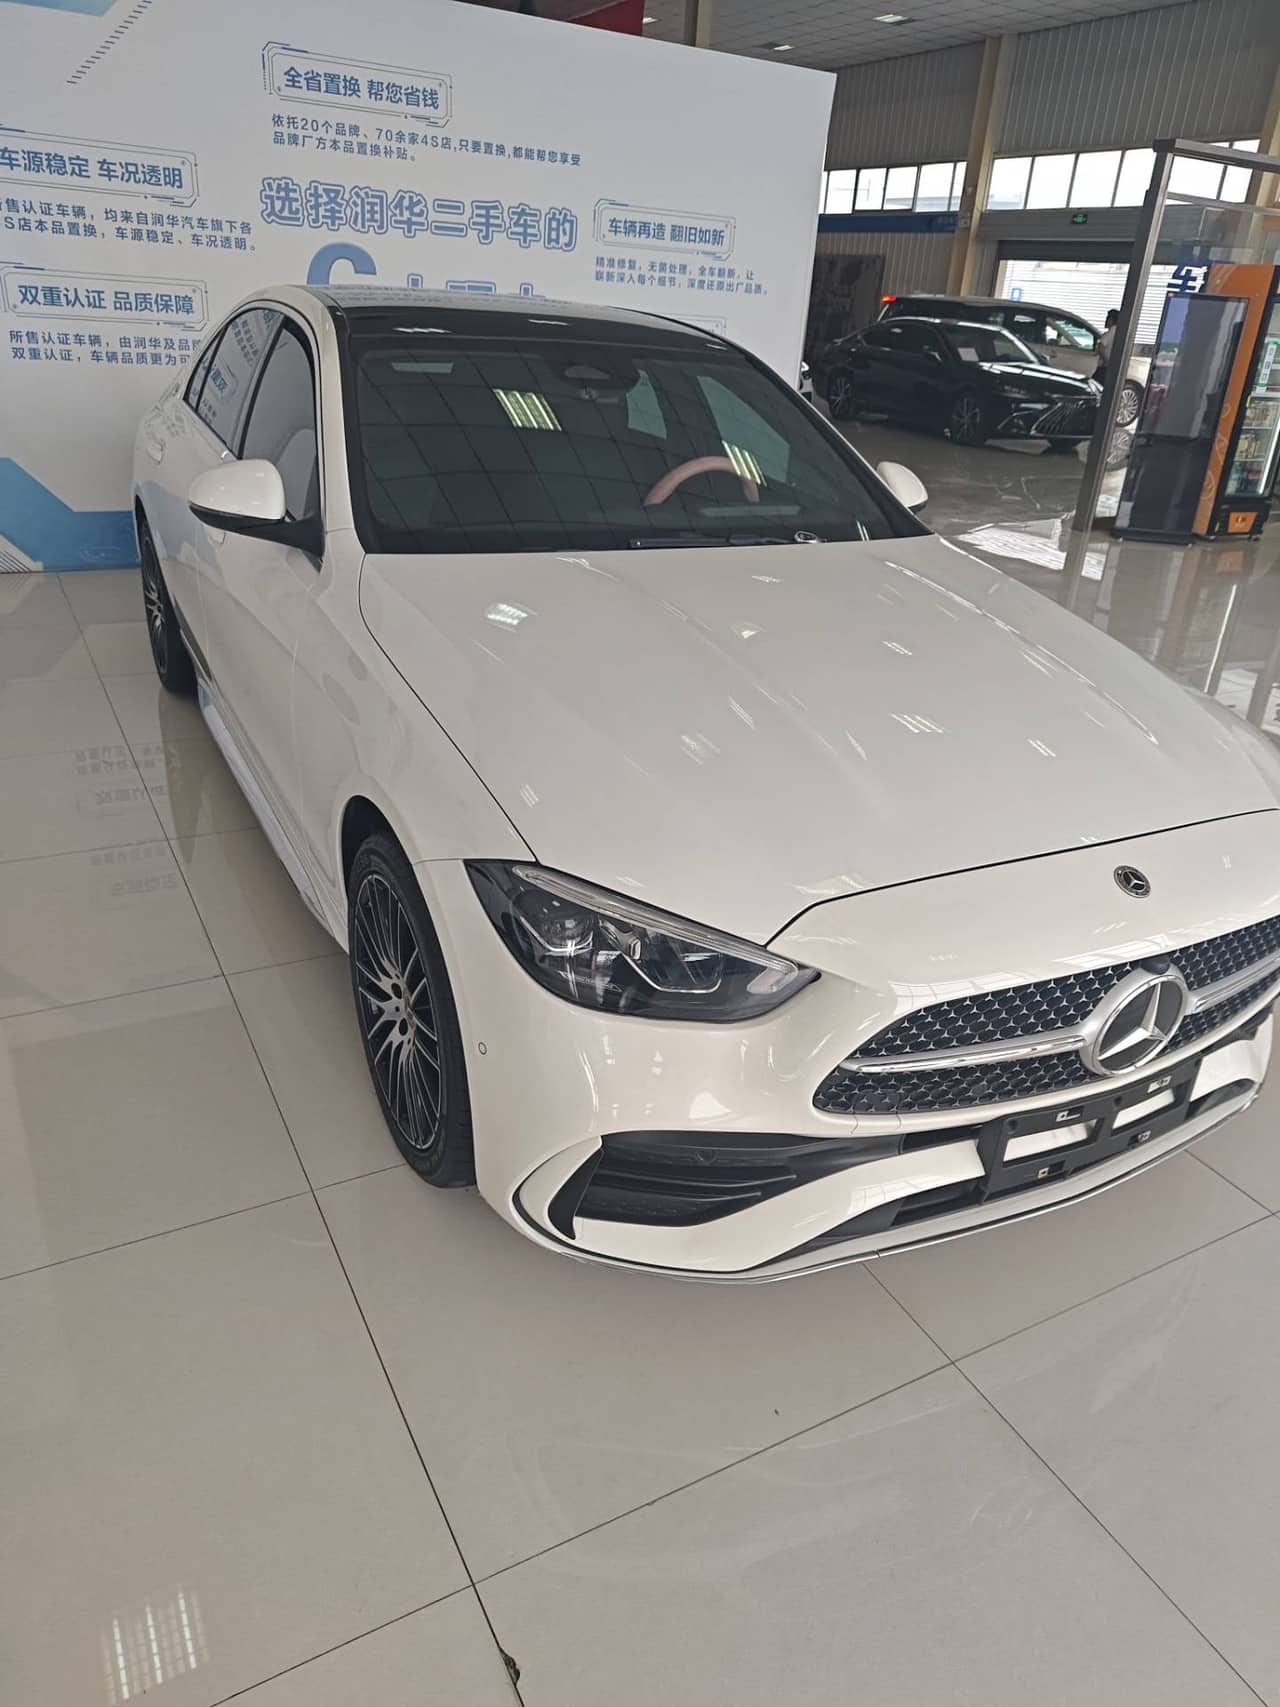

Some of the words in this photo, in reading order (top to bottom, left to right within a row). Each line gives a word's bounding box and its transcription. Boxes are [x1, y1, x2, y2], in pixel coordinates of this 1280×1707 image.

[283, 66, 361, 100] 全省置换
[366, 79, 440, 110] 帮您省钱
[272, 131, 417, 162] 品牌厂方本品置换补贴。
[0, 146, 91, 179] 车源稳定
[97, 158, 183, 190] 车况透明
[0, 197, 253, 235] 售认证车辆，均来自润华汽车旗下各
[259, 175, 578, 252] 选择润华二手车的
[607, 217, 666, 241] 车辆再造
[670, 224, 725, 247] 翻旧如新
[18, 284, 107, 311] 双重认证
[113, 292, 195, 316] 品质保障
